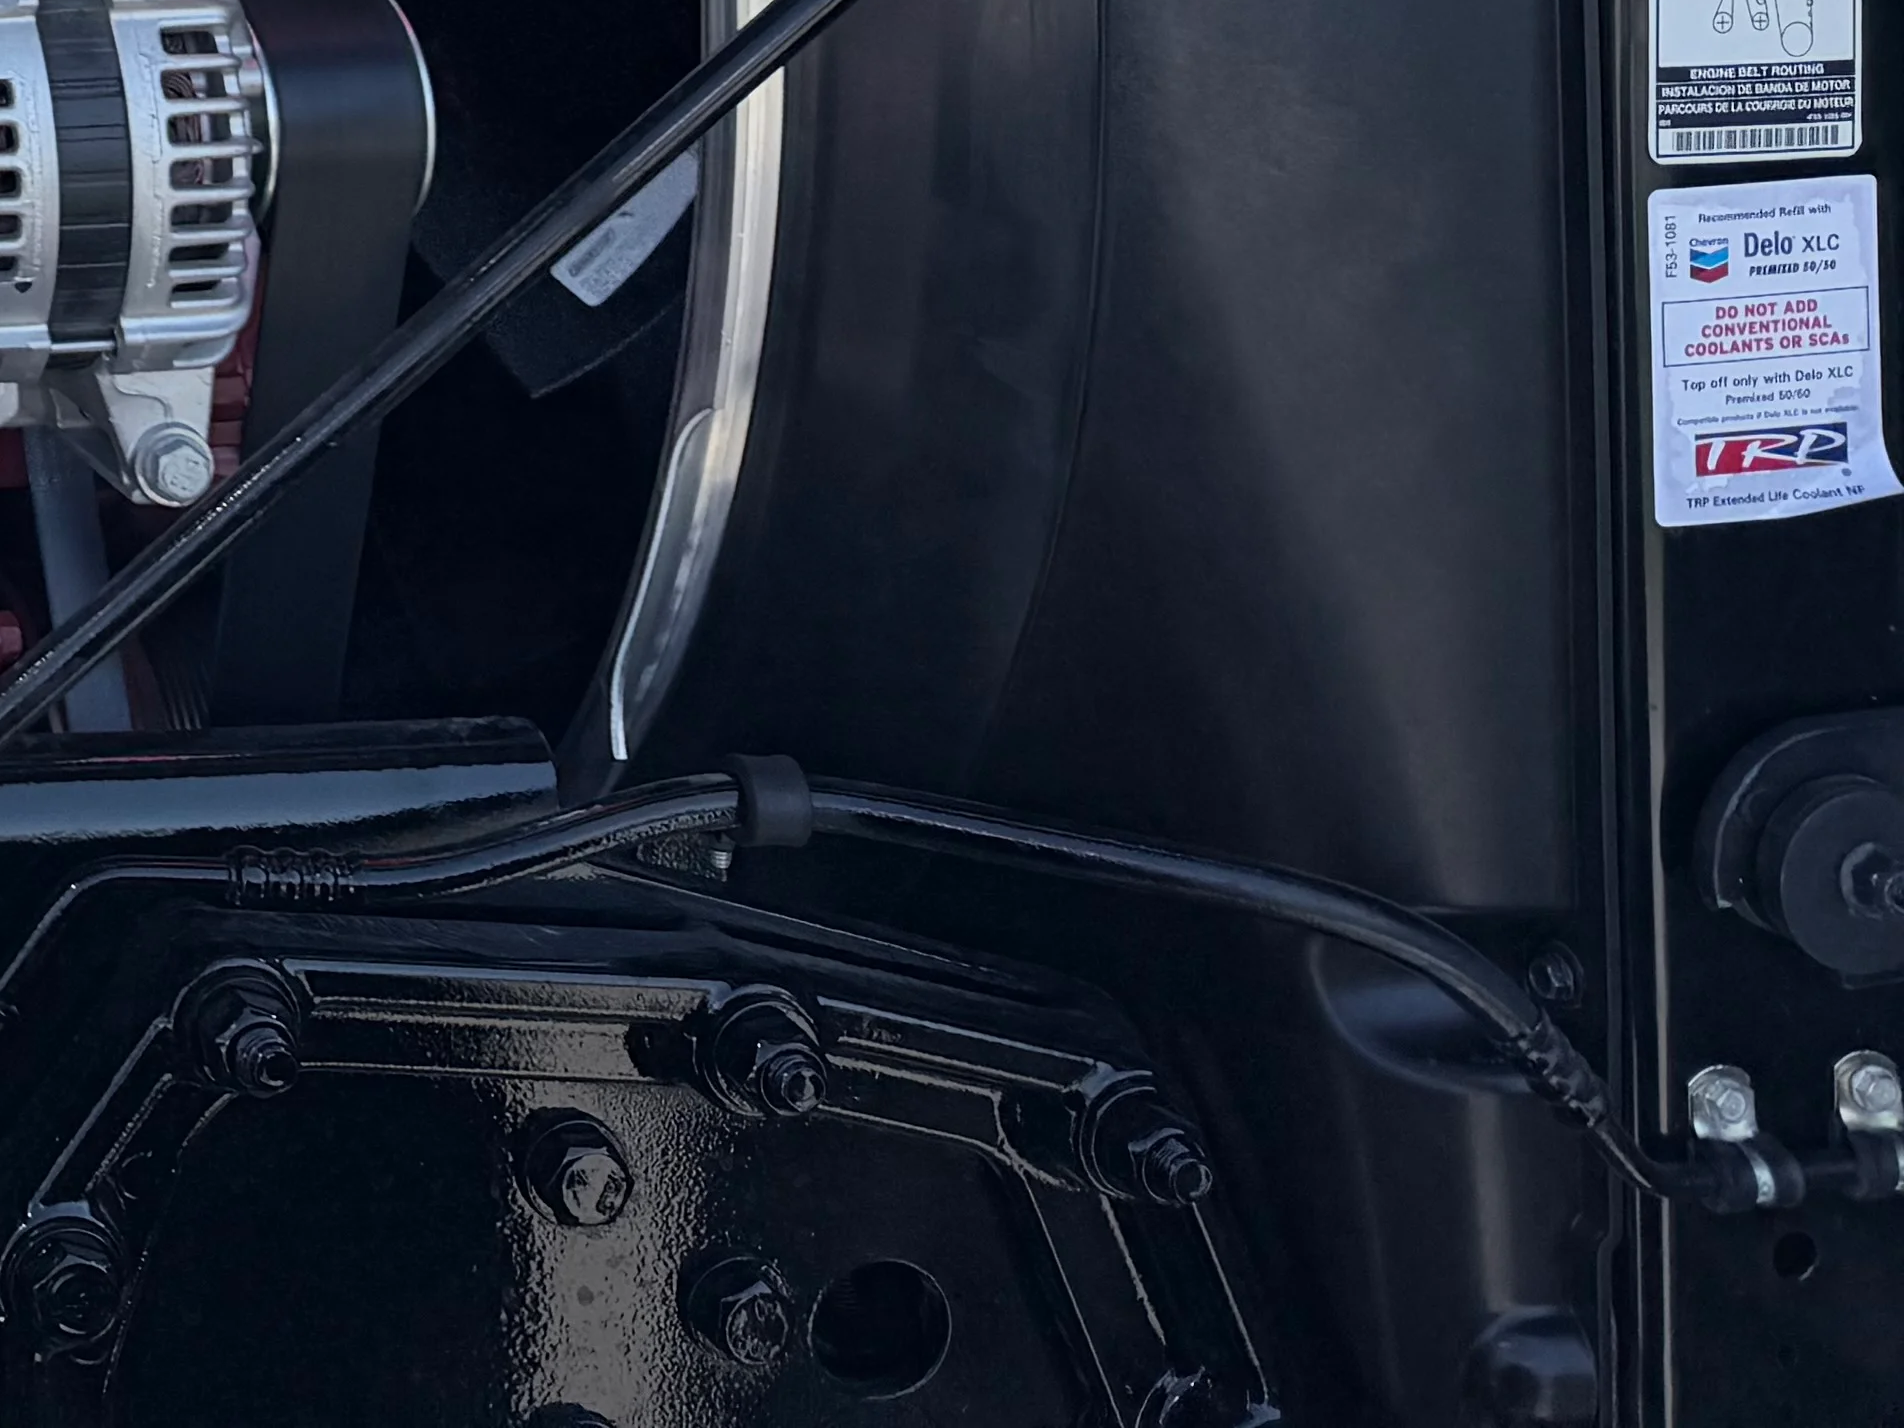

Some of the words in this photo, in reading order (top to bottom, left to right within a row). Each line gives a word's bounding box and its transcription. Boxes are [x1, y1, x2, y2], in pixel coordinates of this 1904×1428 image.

[1690, 68, 1736, 81] ENGINE
[1738, 66, 1767, 78] BELT
[1771, 63, 1824, 76] ROUTING
[1738, 83, 1752, 95] DE
[1795, 81, 1809, 92] DE
[1812, 79, 1851, 92] MOTOR
[1699, 208, 1775, 223] Recommended
[1779, 206, 1805, 217] Refill
[1808, 204, 1831, 214] with
[1665, 216, 1677, 278] F53-1081
[1689, 237, 1729, 247] Chevron
[1744, 231, 1792, 258] Delo
[1802, 234, 1840, 253] XLC
[1716, 306, 1738, 320] DO
[1745, 302, 1778, 318] NOT
[1784, 299, 1817, 313] ADD
[1701, 315, 1832, 338] CONVENTIONAL
[1685, 338, 1774, 357] COOLANTS
[1780, 335, 1802, 349] OR
[1809, 332, 1849, 345] SCAs
[1682, 380, 1706, 392] Top
[1711, 377, 1727, 388] off
[1733, 375, 1758, 388] only
[1763, 372, 1790, 384] with
[1795, 369, 1823, 381] Delo
[1828, 366, 1853, 379] XLC
[1696, 429, 1848, 471] TRP
[1687, 498, 1709, 509] TRP
[1714, 492, 1765, 506] Extended
[1769, 490, 1788, 501] Life
[1793, 487, 1842, 500] Coolant
